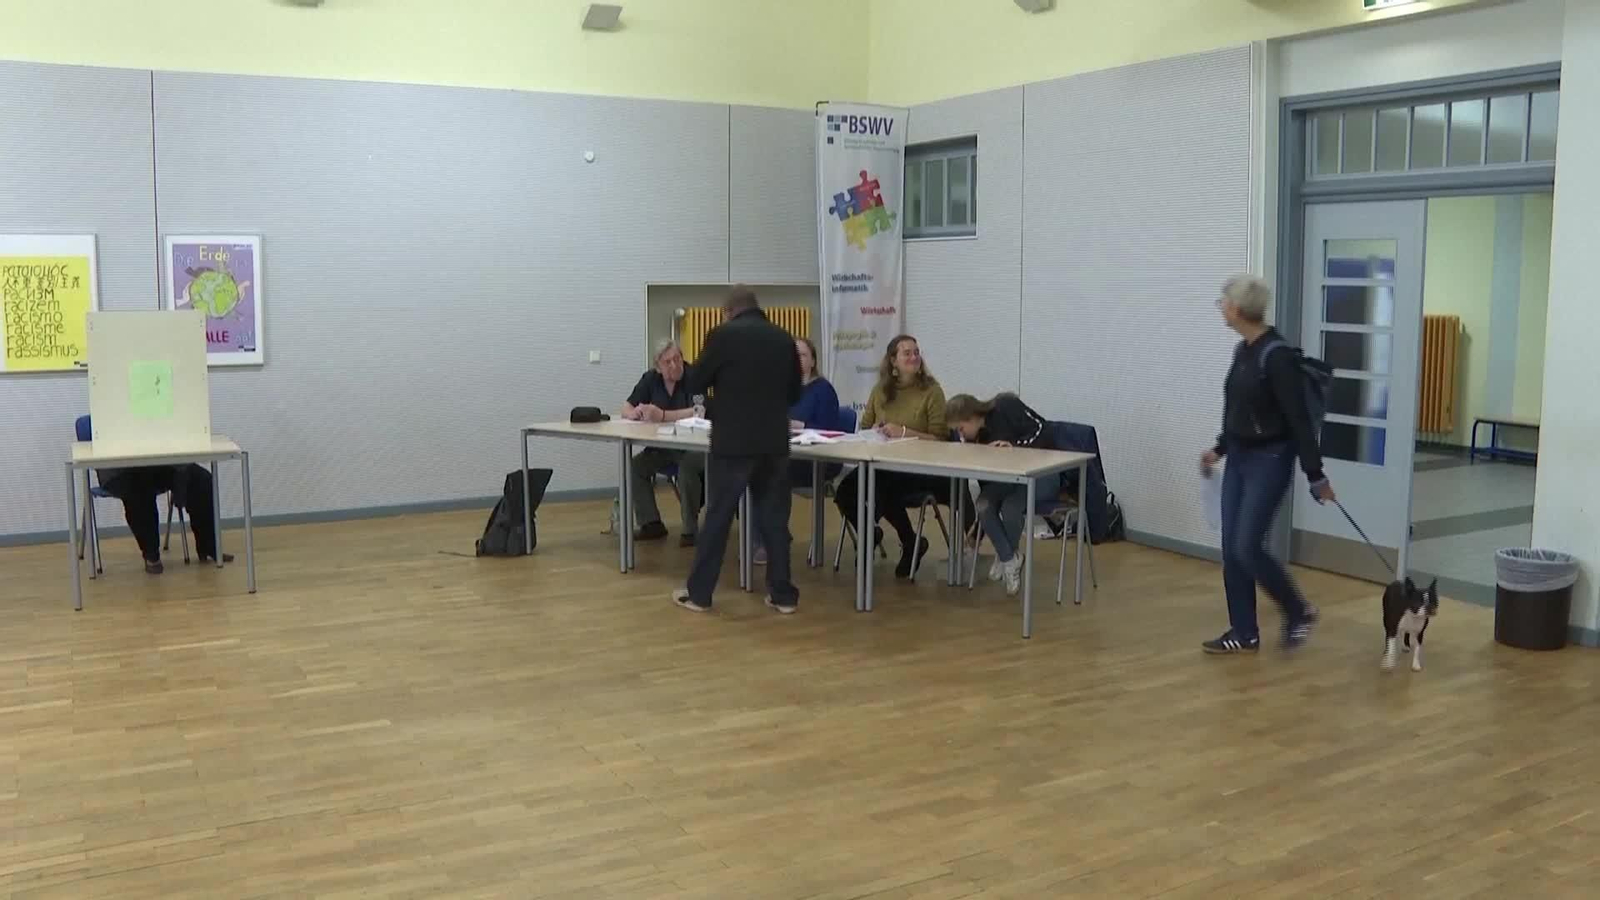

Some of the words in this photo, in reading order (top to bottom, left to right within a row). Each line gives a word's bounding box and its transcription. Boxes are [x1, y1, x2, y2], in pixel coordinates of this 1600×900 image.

[849, 115, 893, 135] BSWV
[199, 245, 230, 261] Erde
[4, 300, 60, 312] racizem
[5, 311, 63, 323] racismo
[6, 322, 64, 335] racisme
[7, 333, 57, 346] racism
[7, 344, 79, 359] rassismus
